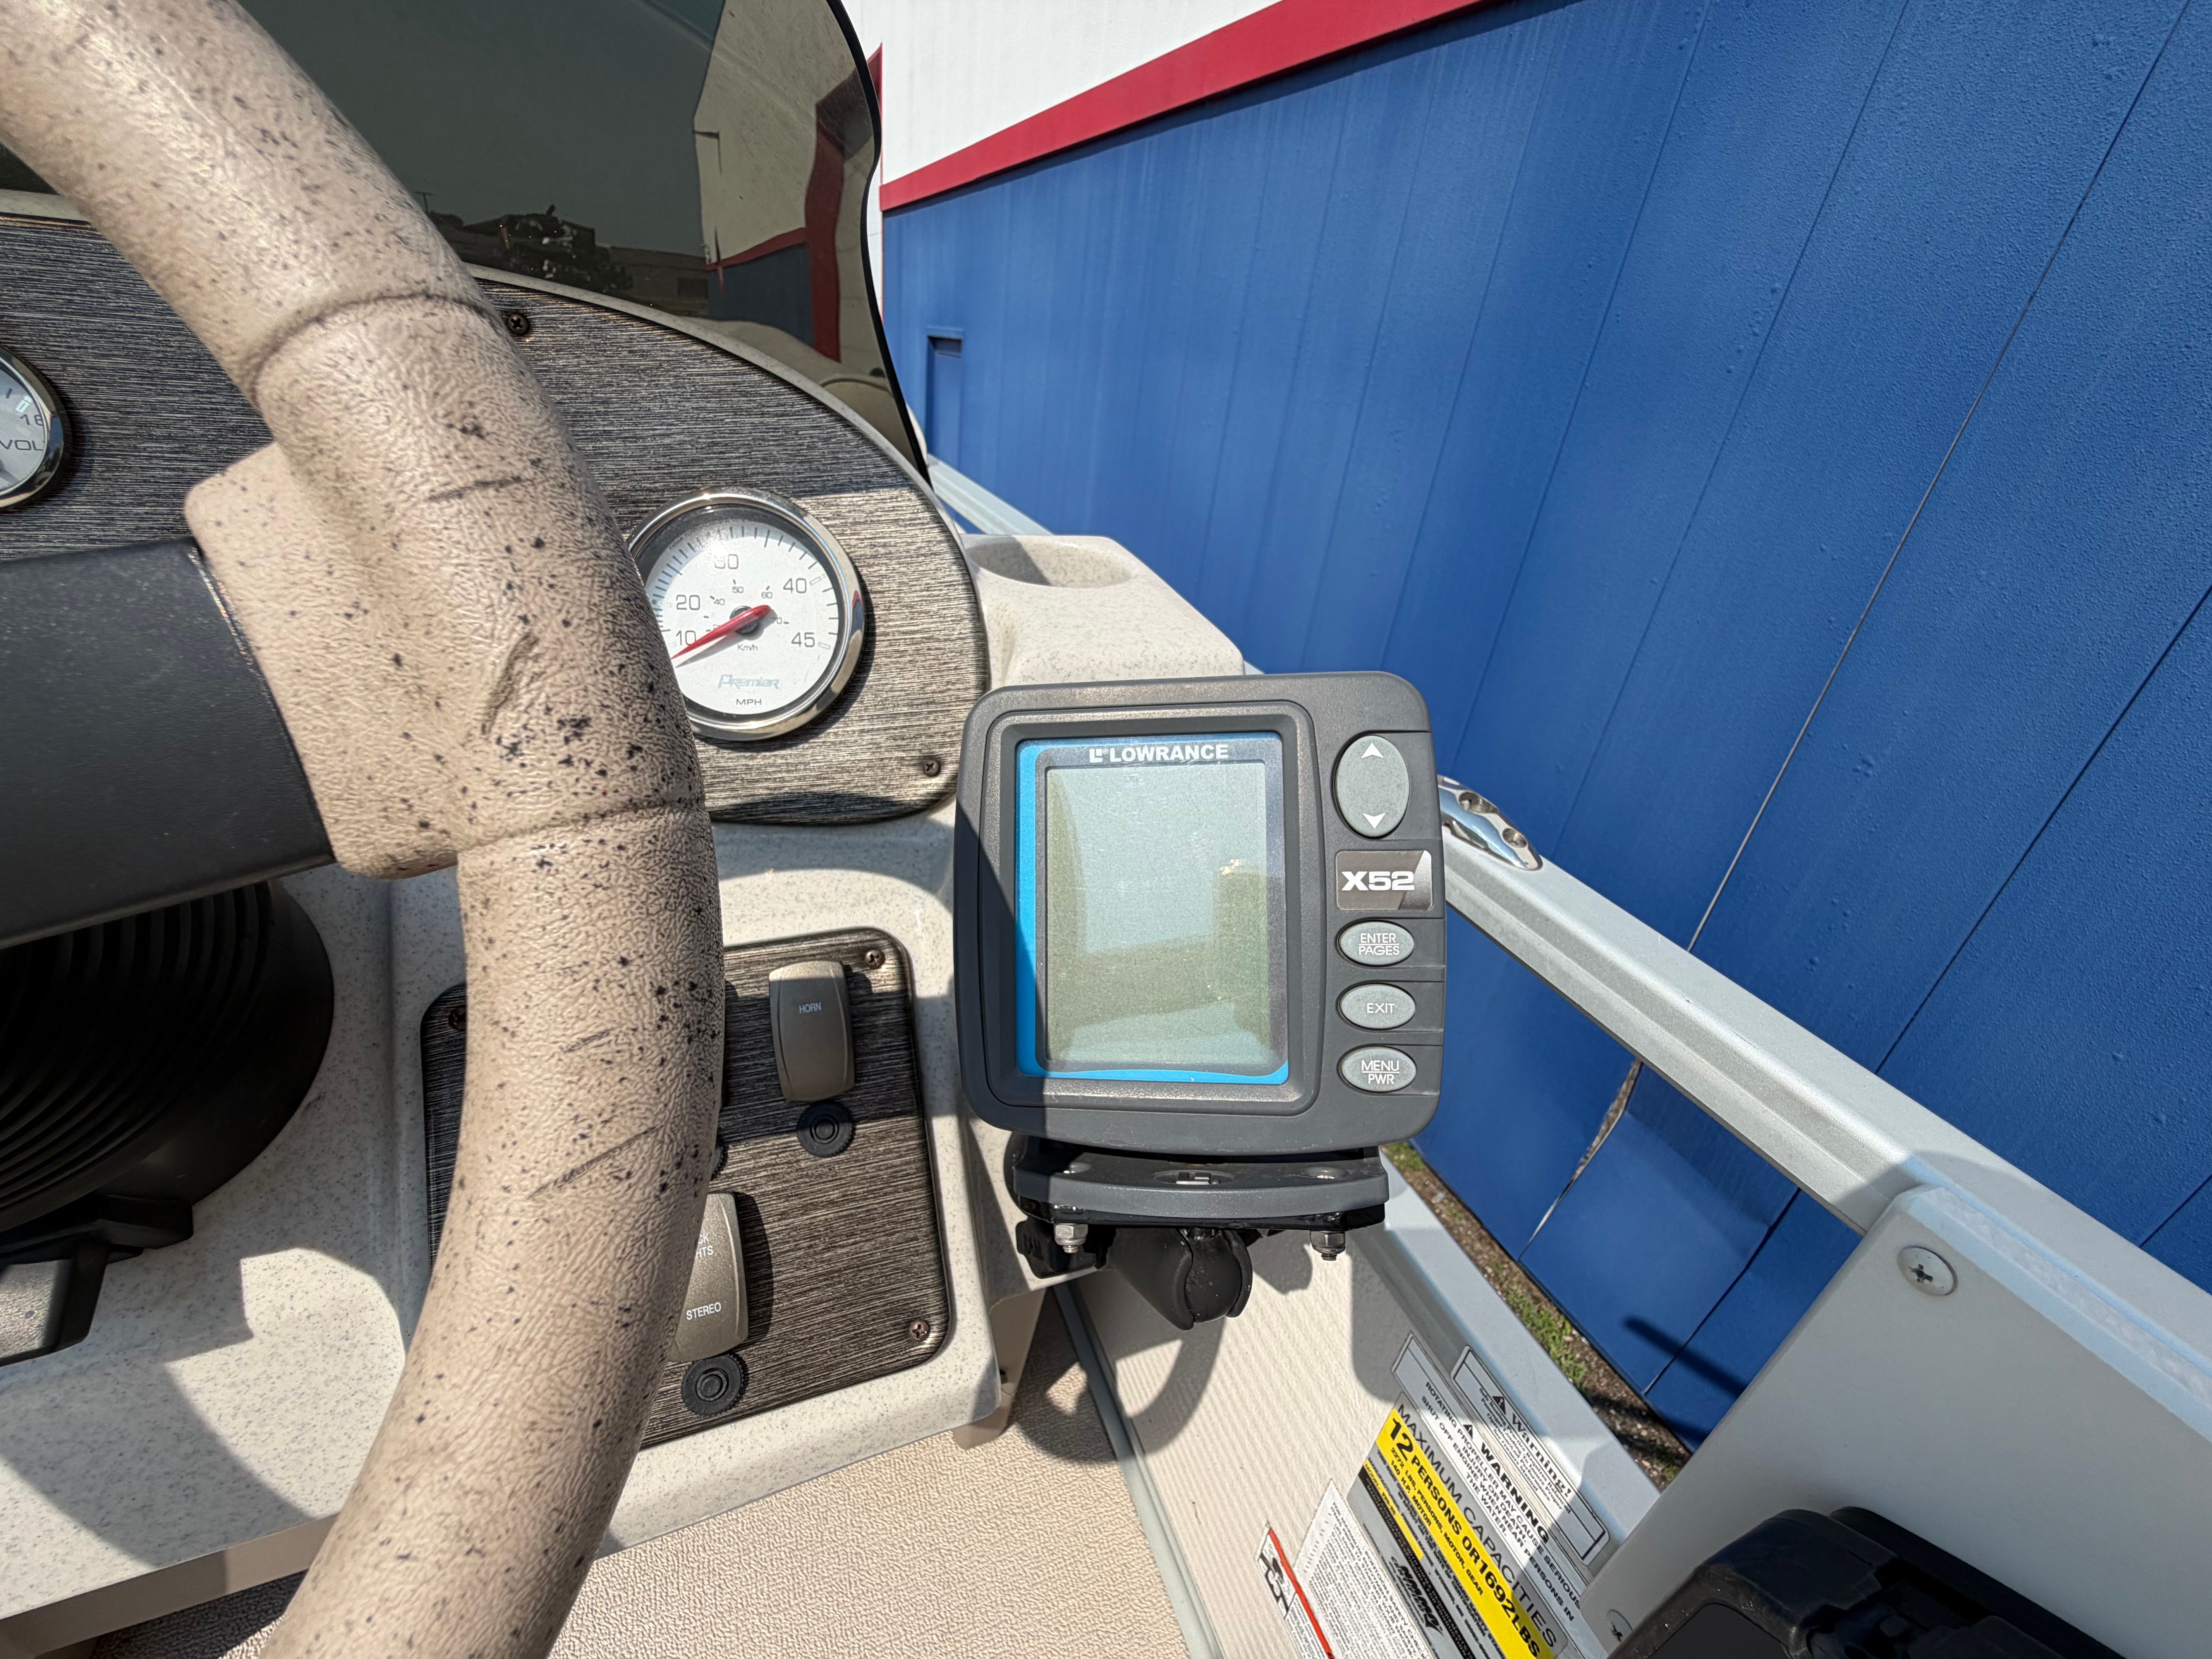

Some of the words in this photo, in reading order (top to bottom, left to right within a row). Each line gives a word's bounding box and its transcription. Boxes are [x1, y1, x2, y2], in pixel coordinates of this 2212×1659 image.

[0, 440, 45, 451] VOL
[676, 594, 700, 610] 20
[783, 578, 807, 594] 40
[676, 630, 696, 646] 10
[791, 632, 815, 647] 45
[1110, 744, 1228, 762] LOWRANCE
[1341, 871, 1415, 890] X52
[1358, 946, 1400, 955] PAGES
[1360, 933, 1396, 943] ENTER
[805, 1002, 822, 1014] HORN
[1367, 1003, 1395, 1013] EXIT
[1362, 1060, 1400, 1071] MENU
[1368, 1073, 1394, 1084] PWR
[686, 1302, 721, 1321] STEREO
[1386, 1415, 1415, 1462] 12
[1410, 1454, 1463, 1537] PERSONS
[1510, 1412, 1571, 1502] Warning!
[1525, 1451, 1547, 1484] Requires
[1390, 1459, 1401, 1477] 140
[1412, 1494, 1432, 1527] MOTOR
[1425, 1381, 1457, 1429] ROTATING
[1457, 1427, 1499, 1490] PROPELLER
[1499, 1489, 1516, 1515] MAY
[1516, 1513, 1544, 1556] CAUSE
[1544, 1553, 1582, 1611] SERIOUS
[1462, 1445, 1488, 1484] INJURY
[1487, 1483, 1500, 1502] OR
[1500, 1501, 1527, 1543] DEATH.
[1465, 1471, 1480, 1495] THE
[1482, 1497, 1508, 1537] WATER.
[1479, 1441, 1550, 1546] WARNING
[1521, 1453, 1529, 1465] To
[1544, 1486, 1563, 1513] Proper
[1390, 1446, 1405, 1469] 2272
[1417, 1489, 1444, 1534] PERSONS,
[1443, 1531, 1467, 1570] MOTOR,
[1465, 1567, 1484, 1596] GEAR
[1397, 1402, 1463, 1505] MAXIMUM
[1462, 1503, 1557, 1650] CAPACITIES
[1421, 1395, 1439, 1423] SHUT
[1439, 1420, 1453, 1443] OFF
[1453, 1441, 1479, 1482] ENGINE
[1479, 1480, 1502, 1515] WHEN
[1501, 1513, 1524, 1548] NEAR
[1524, 1546, 1564, 1607] PERSONS
[1564, 1605, 1575, 1623] IN
[1390, 1555, 1425, 1614] CERTIFIED
[1425, 1536, 1433, 1551] THE
[1433, 1549, 1445, 1570] DATE
[1444, 1569, 1451, 1580] OF
[1451, 1579, 1486, 1637] CERTIFICATION
[1437, 1549, 1453, 1575] COAST
[1452, 1573, 1469, 1602] GUARD
[1469, 1601, 1488, 1632] SAFETY
[1487, 1632, 1505, 1659] STAND
[1431, 1589, 1467, 1651] REQUIREMENTS
[1436, 1603, 1467, 1657] PRODUCTION
[1455, 1603, 1464, 1618] MN
